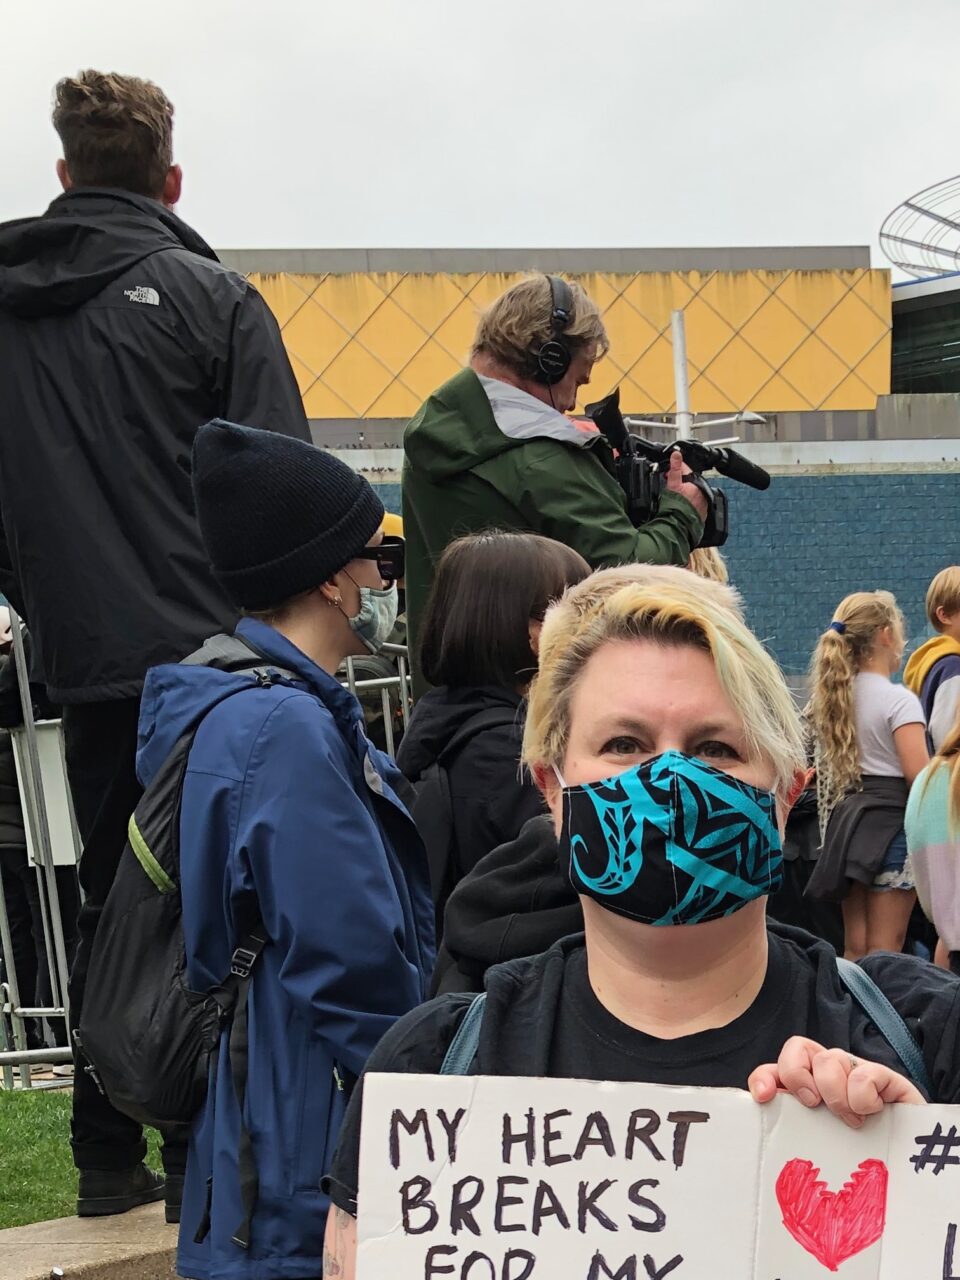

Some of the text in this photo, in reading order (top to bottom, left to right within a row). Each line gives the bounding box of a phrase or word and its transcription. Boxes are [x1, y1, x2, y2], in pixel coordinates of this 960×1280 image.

[390, 1107, 710, 1170] MY HEART
[399, 1175, 666, 1236] BREAKS
